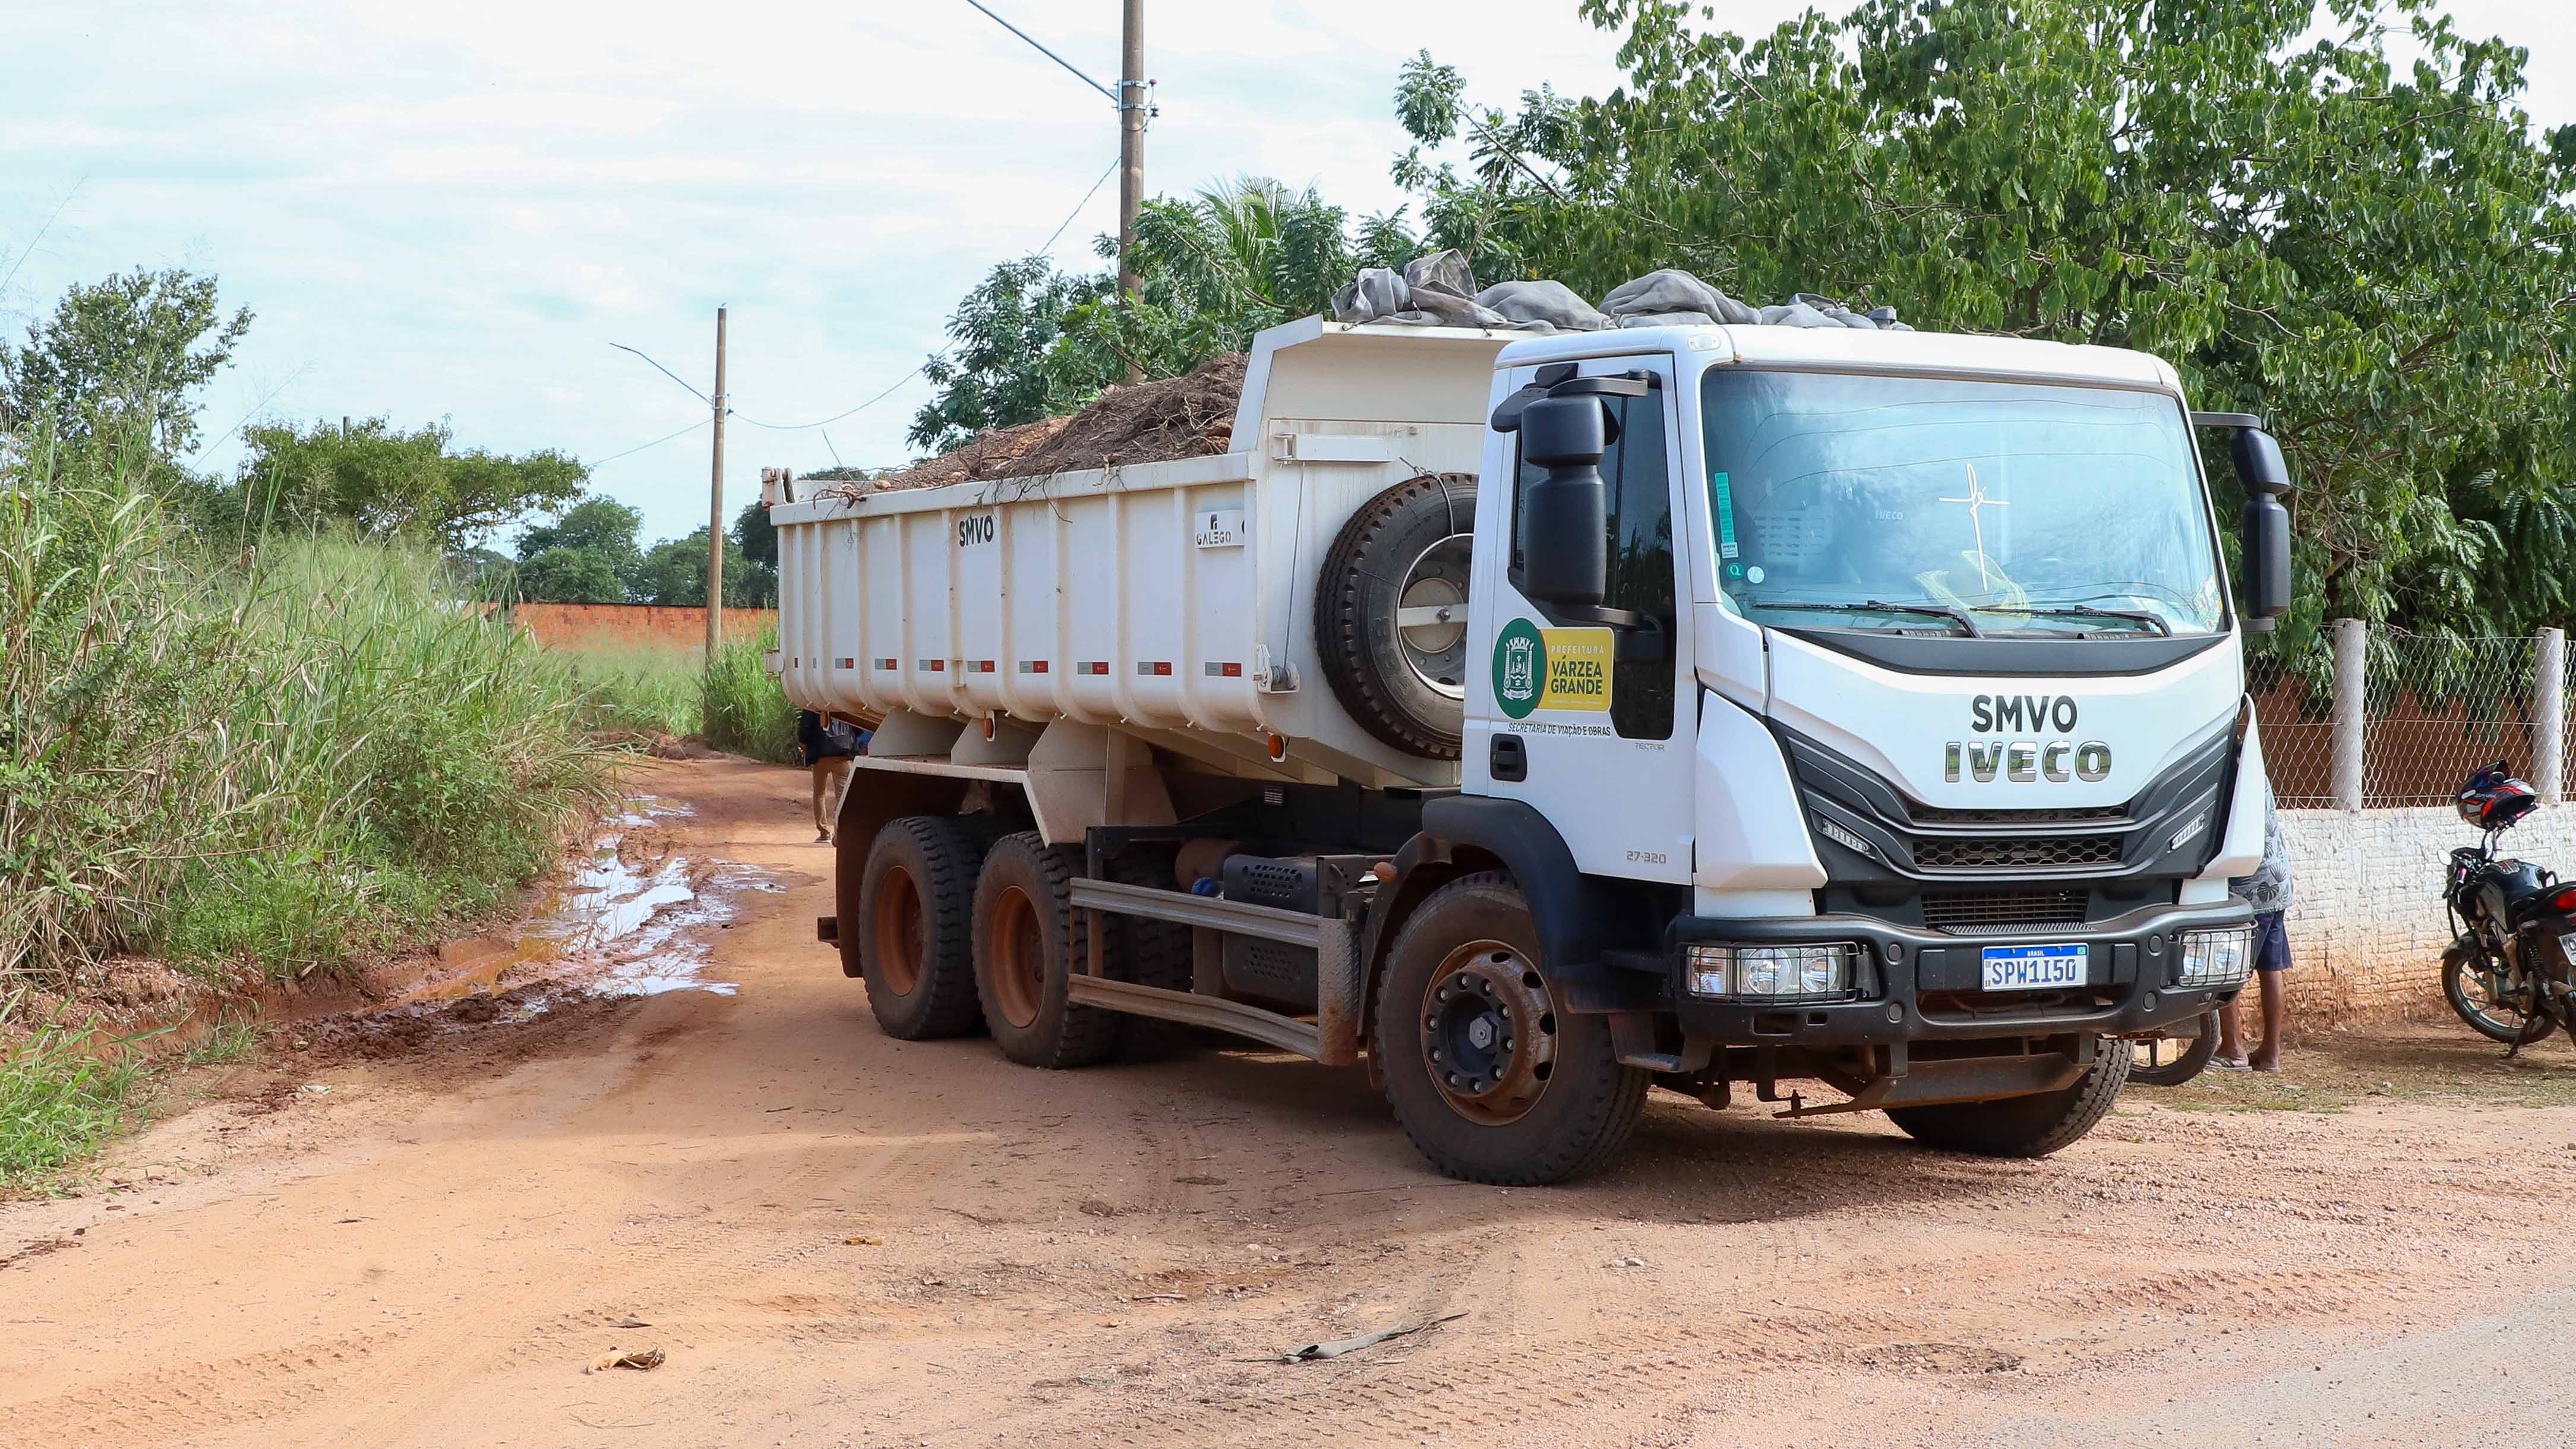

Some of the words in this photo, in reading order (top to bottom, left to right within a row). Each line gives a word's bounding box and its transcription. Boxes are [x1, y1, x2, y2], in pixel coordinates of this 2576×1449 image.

[959, 515, 994, 547] SMVO
[1197, 531, 1231, 545] GALEGO
[1551, 645, 1604, 655] PREFEITURA
[1552, 654, 1602, 677] VÁRZEA
[1551, 678, 1603, 694] GRANDE
[1972, 694, 2078, 733] SMVO
[1508, 722, 1546, 734] SECRETARIA
[1548, 725, 1557, 734] DE
[1583, 726, 1587, 735] E
[1589, 726, 1611, 737] OBRAS
[1944, 741, 2111, 783] IVECO
[1992, 959, 2076, 985] SPW1I50
